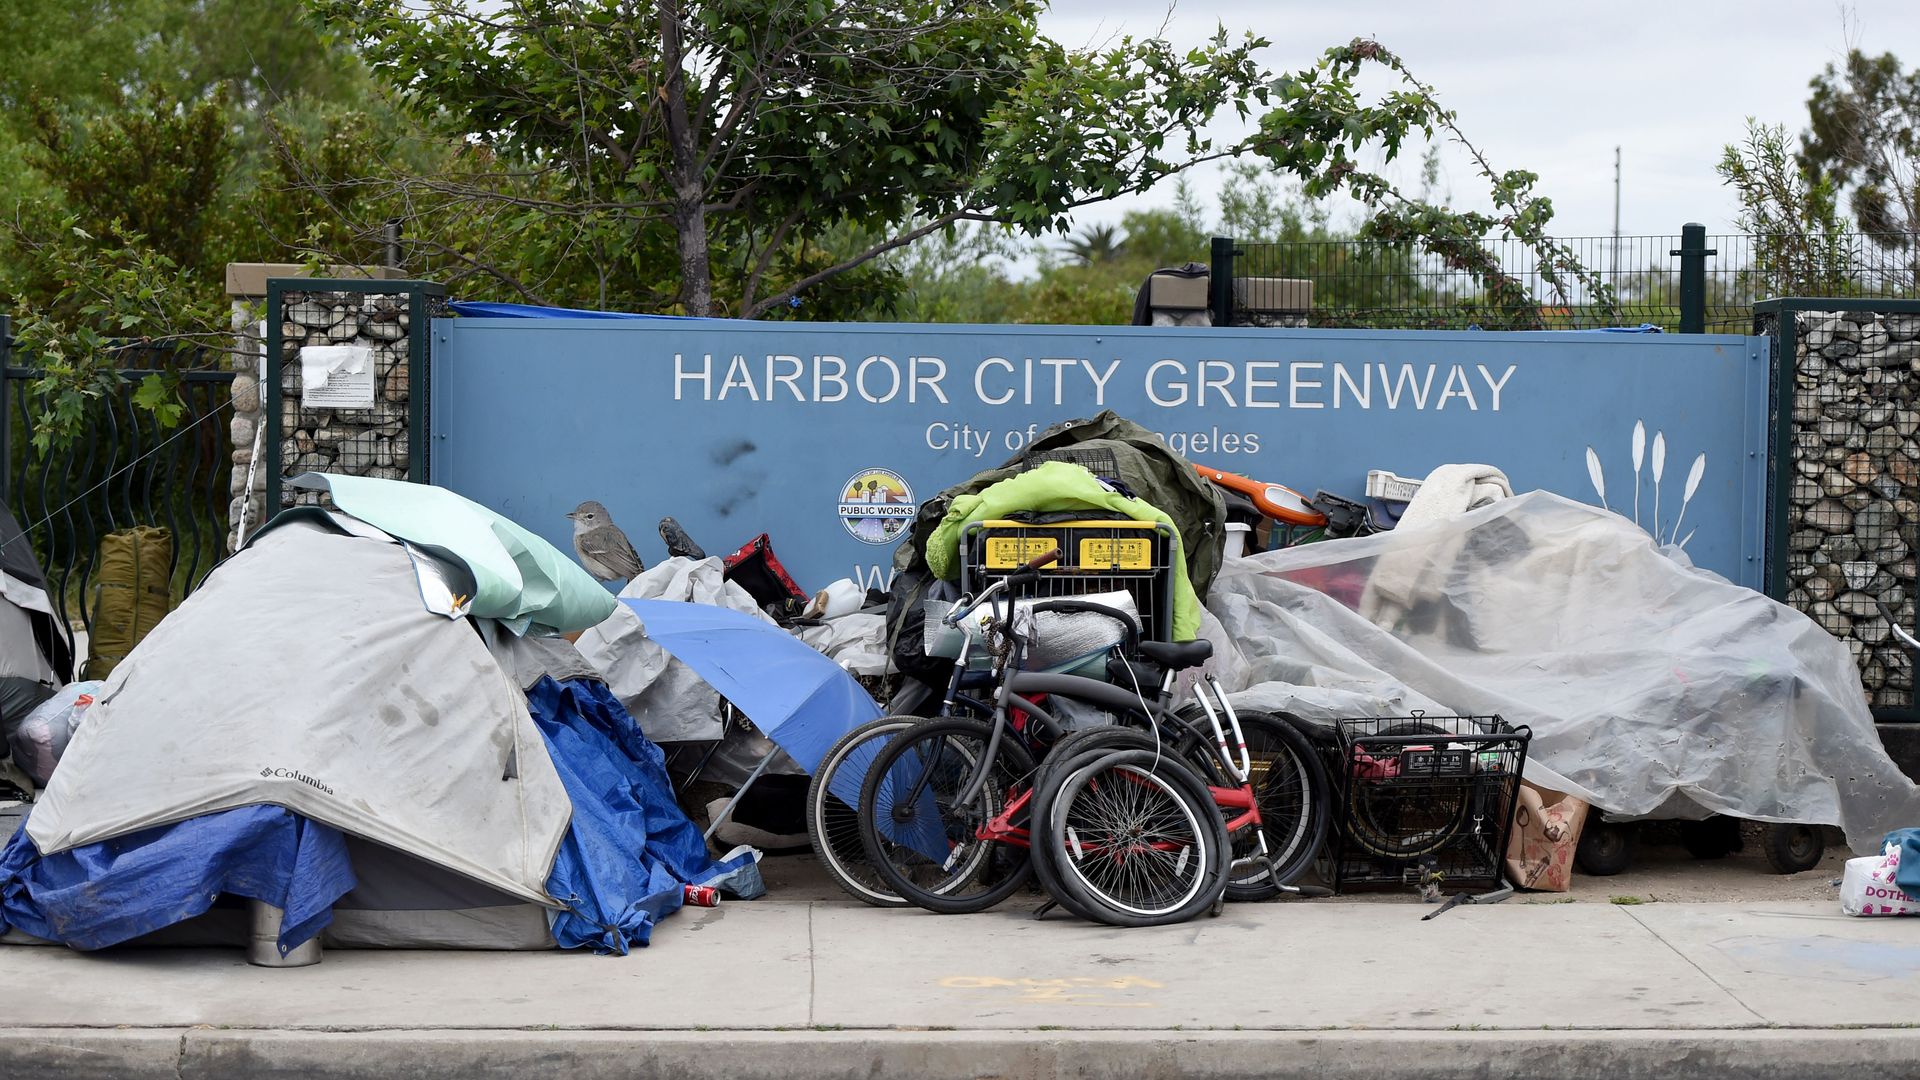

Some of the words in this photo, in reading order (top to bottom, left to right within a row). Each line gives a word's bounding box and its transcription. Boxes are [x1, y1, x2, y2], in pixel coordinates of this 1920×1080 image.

[674, 353, 949, 404] HARBOR
[974, 357, 1121, 406] CITY
[1144, 359, 1517, 411] GREENWAY
[925, 422, 991, 457] City
[1004, 423, 1038, 450] of
[1156, 426, 1260, 458] geles
[840, 506, 875, 515] PUBLIC
[878, 506, 914, 515] WORKS
[273, 767, 334, 795] Columbia
